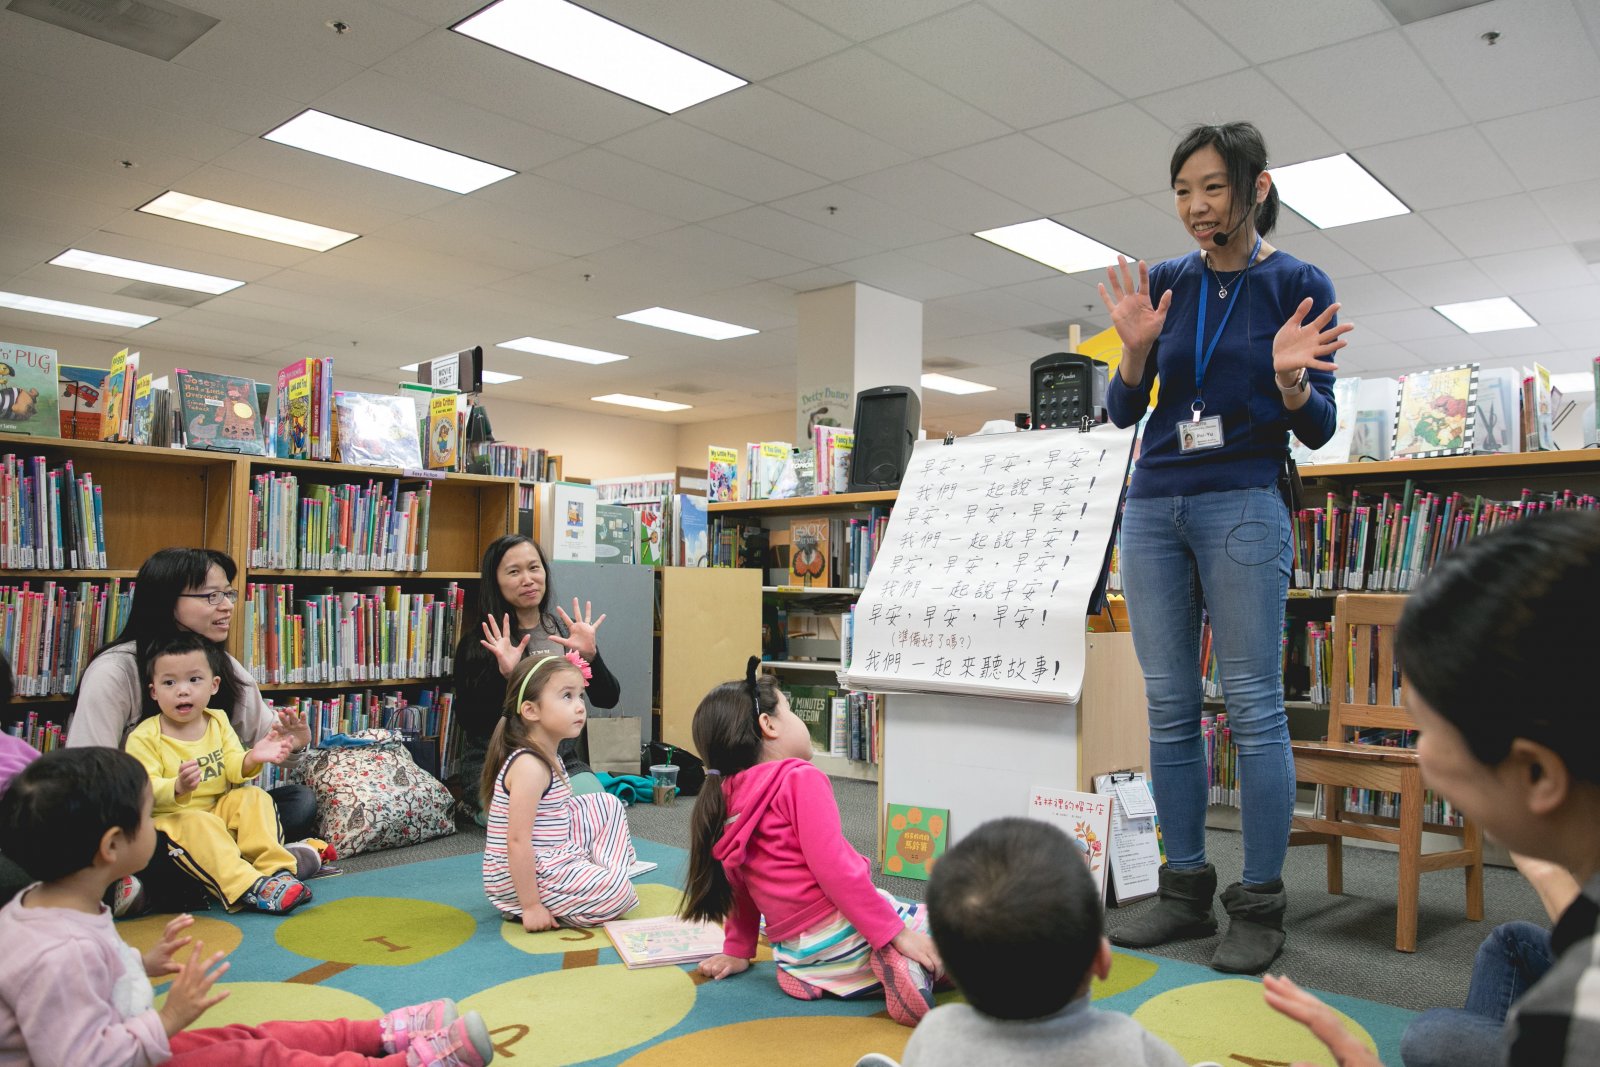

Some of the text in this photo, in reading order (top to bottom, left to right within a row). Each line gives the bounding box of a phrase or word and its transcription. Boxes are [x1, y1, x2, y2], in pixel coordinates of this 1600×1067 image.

[16, 349, 50, 374] PUG
[793, 524, 827, 541] LOOK
[796, 697, 825, 710] MINUTES
